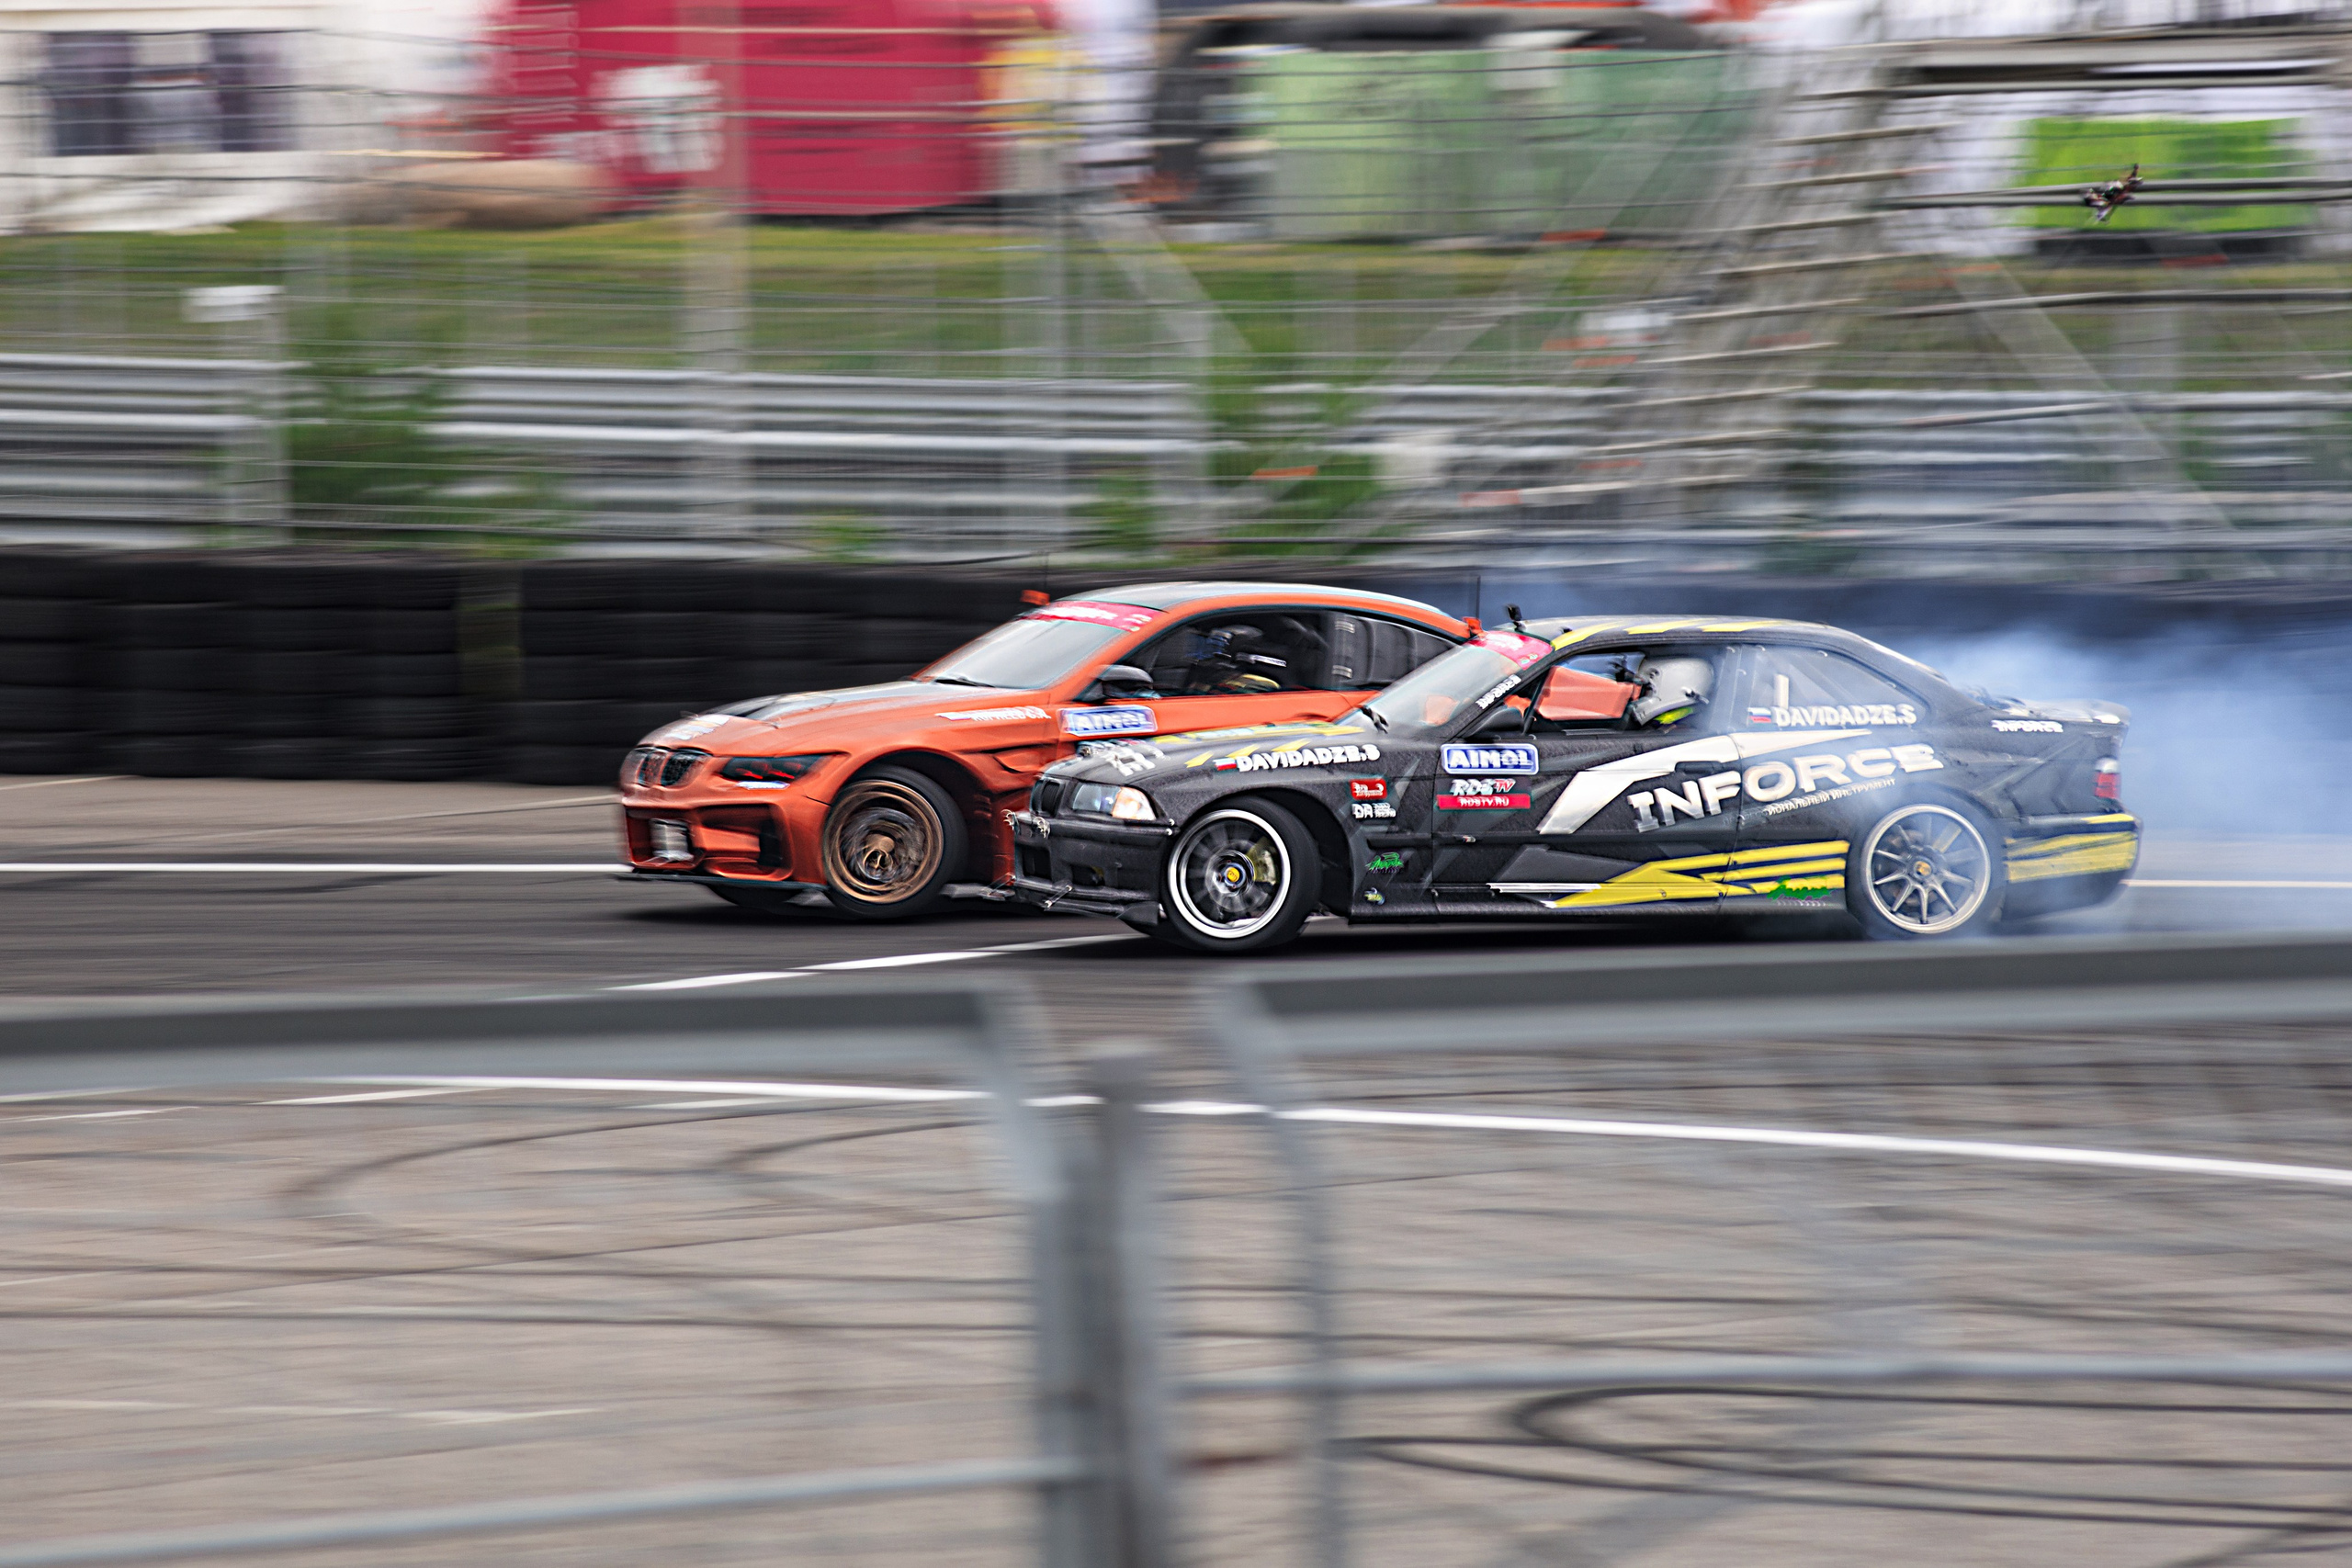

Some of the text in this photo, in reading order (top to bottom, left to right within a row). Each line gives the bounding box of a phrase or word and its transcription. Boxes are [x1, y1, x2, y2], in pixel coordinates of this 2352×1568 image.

[1772, 703, 1917, 728] DAVIDADZE.S
[1236, 743, 1381, 773] DAVIDADZE.S
[1449, 749, 1533, 769] AIMOL
[1627, 743, 1944, 833] INFORCE
